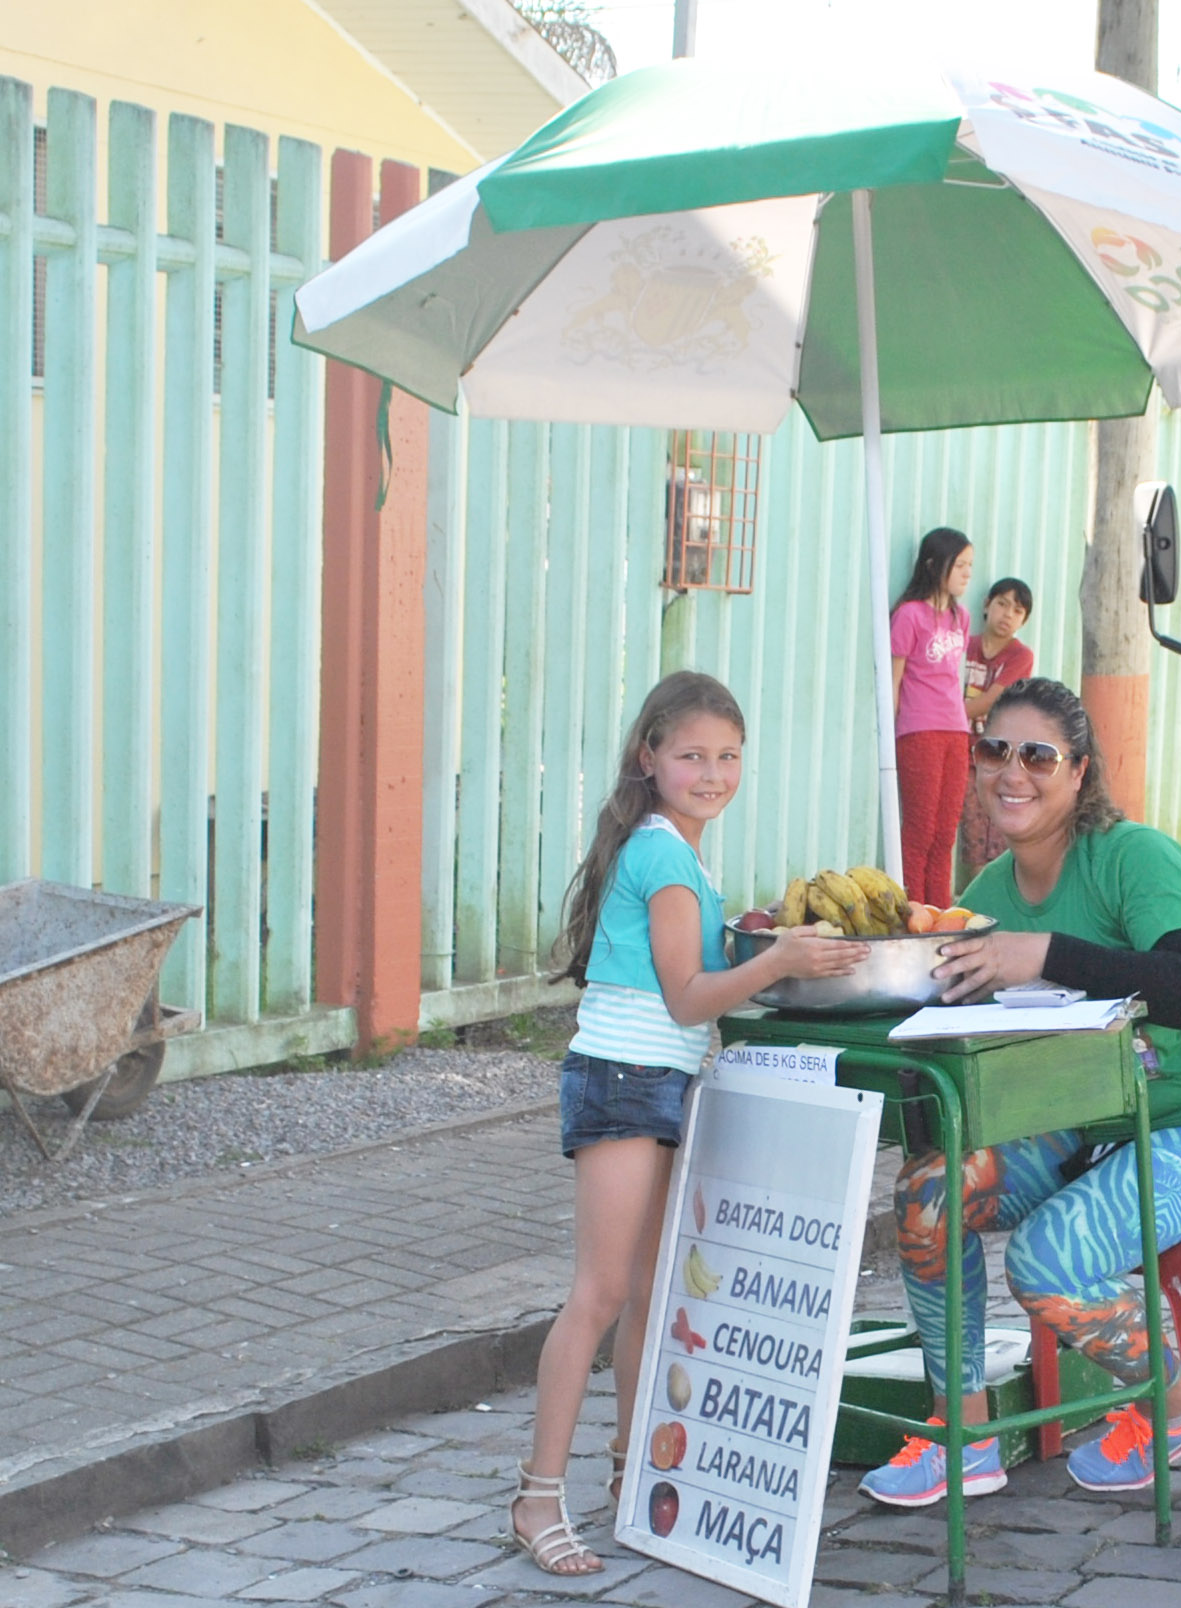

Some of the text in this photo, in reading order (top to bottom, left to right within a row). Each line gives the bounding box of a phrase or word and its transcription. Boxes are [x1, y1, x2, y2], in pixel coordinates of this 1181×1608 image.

[719, 1049, 753, 1066] ACIMA
[755, 1052, 770, 1066] DE
[772, 1054, 779, 1067] 5
[781, 1054, 797, 1069] KG
[714, 1198, 842, 1251] BATATA DOCE
[729, 1266, 832, 1320] BANANA
[712, 1322, 823, 1381] CENOURA
[699, 1377, 811, 1449] BATATA
[696, 1441, 798, 1502] LARANJA
[694, 1499, 784, 1565] MAÇA
